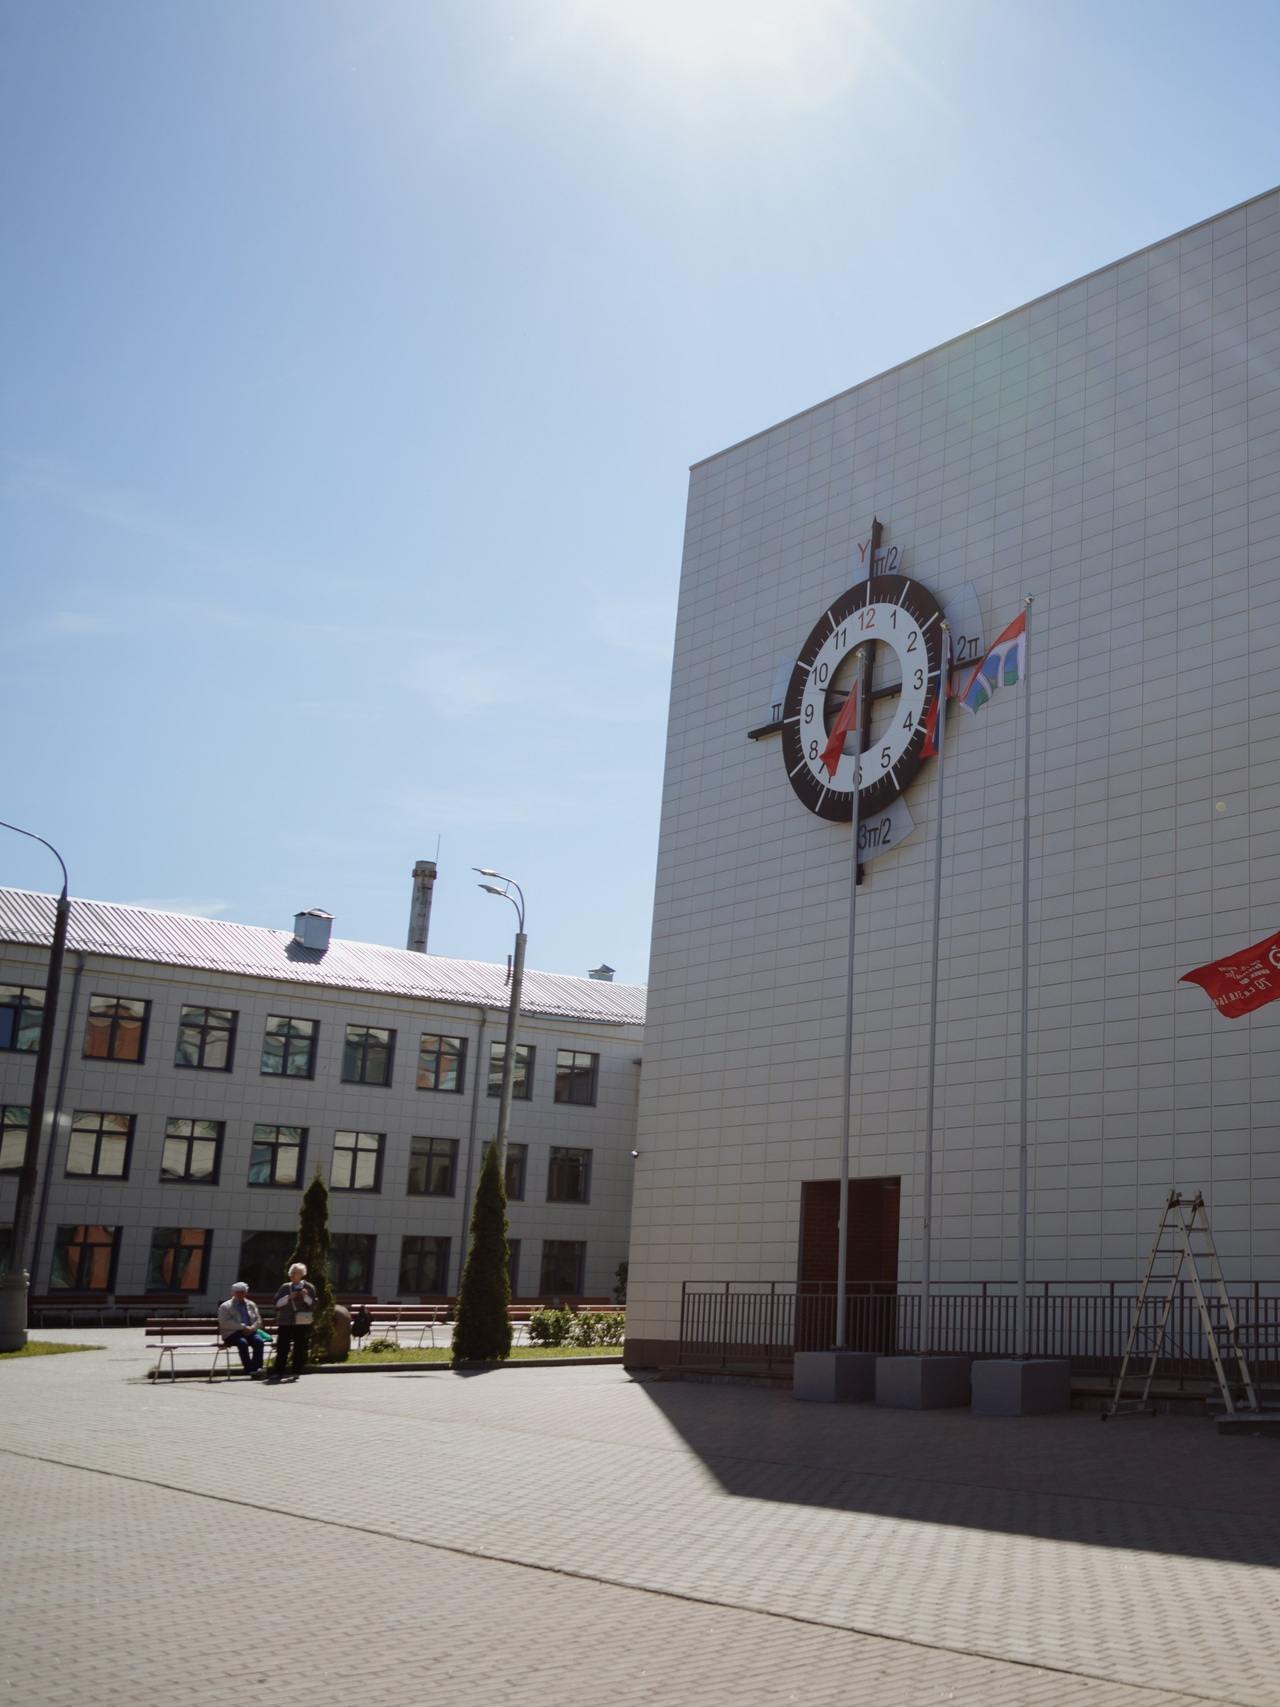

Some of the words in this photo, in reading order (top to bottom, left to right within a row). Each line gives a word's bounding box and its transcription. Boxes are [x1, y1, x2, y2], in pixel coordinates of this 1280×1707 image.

[857, 539, 871, 563] Y
[873, 546, 898, 577] π/2
[857, 608, 876, 631] 12
[890, 610, 898, 630] 1
[833, 632, 848, 650] 11
[906, 631, 918, 653] 2
[957, 635, 980, 663] 2π
[811, 663, 829, 685] 10
[913, 669, 924, 691] 3
[771, 702, 783, 722] π
[804, 704, 815, 724] 9
[903, 711, 913, 733] 4
[809, 740, 818, 760] 8
[881, 746, 891, 768] 5
[858, 817, 891, 850] 3π/2
